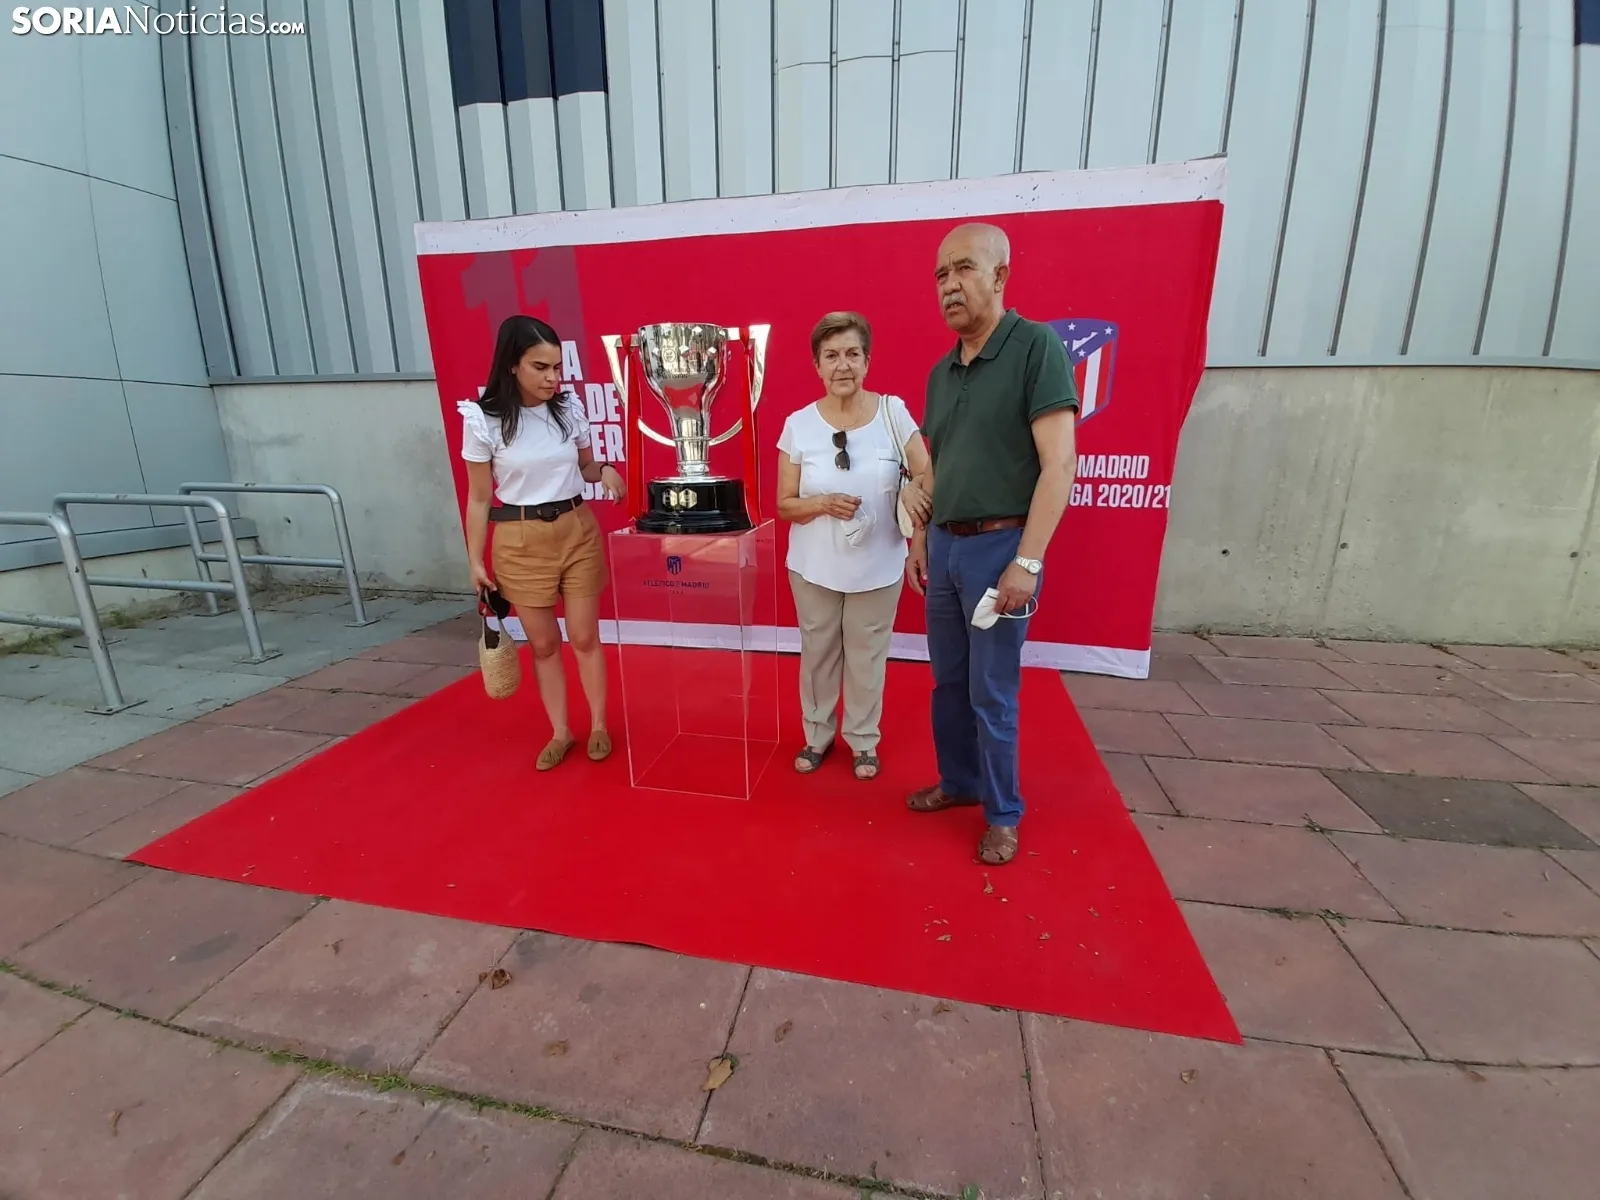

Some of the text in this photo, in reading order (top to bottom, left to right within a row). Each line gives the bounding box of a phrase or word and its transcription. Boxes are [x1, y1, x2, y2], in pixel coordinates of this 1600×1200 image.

[559, 340, 583, 381] A
[590, 424, 626, 462] ER
[1077, 455, 1150, 479] MADRID
[1069, 483, 1171, 508] GA 2020/21
